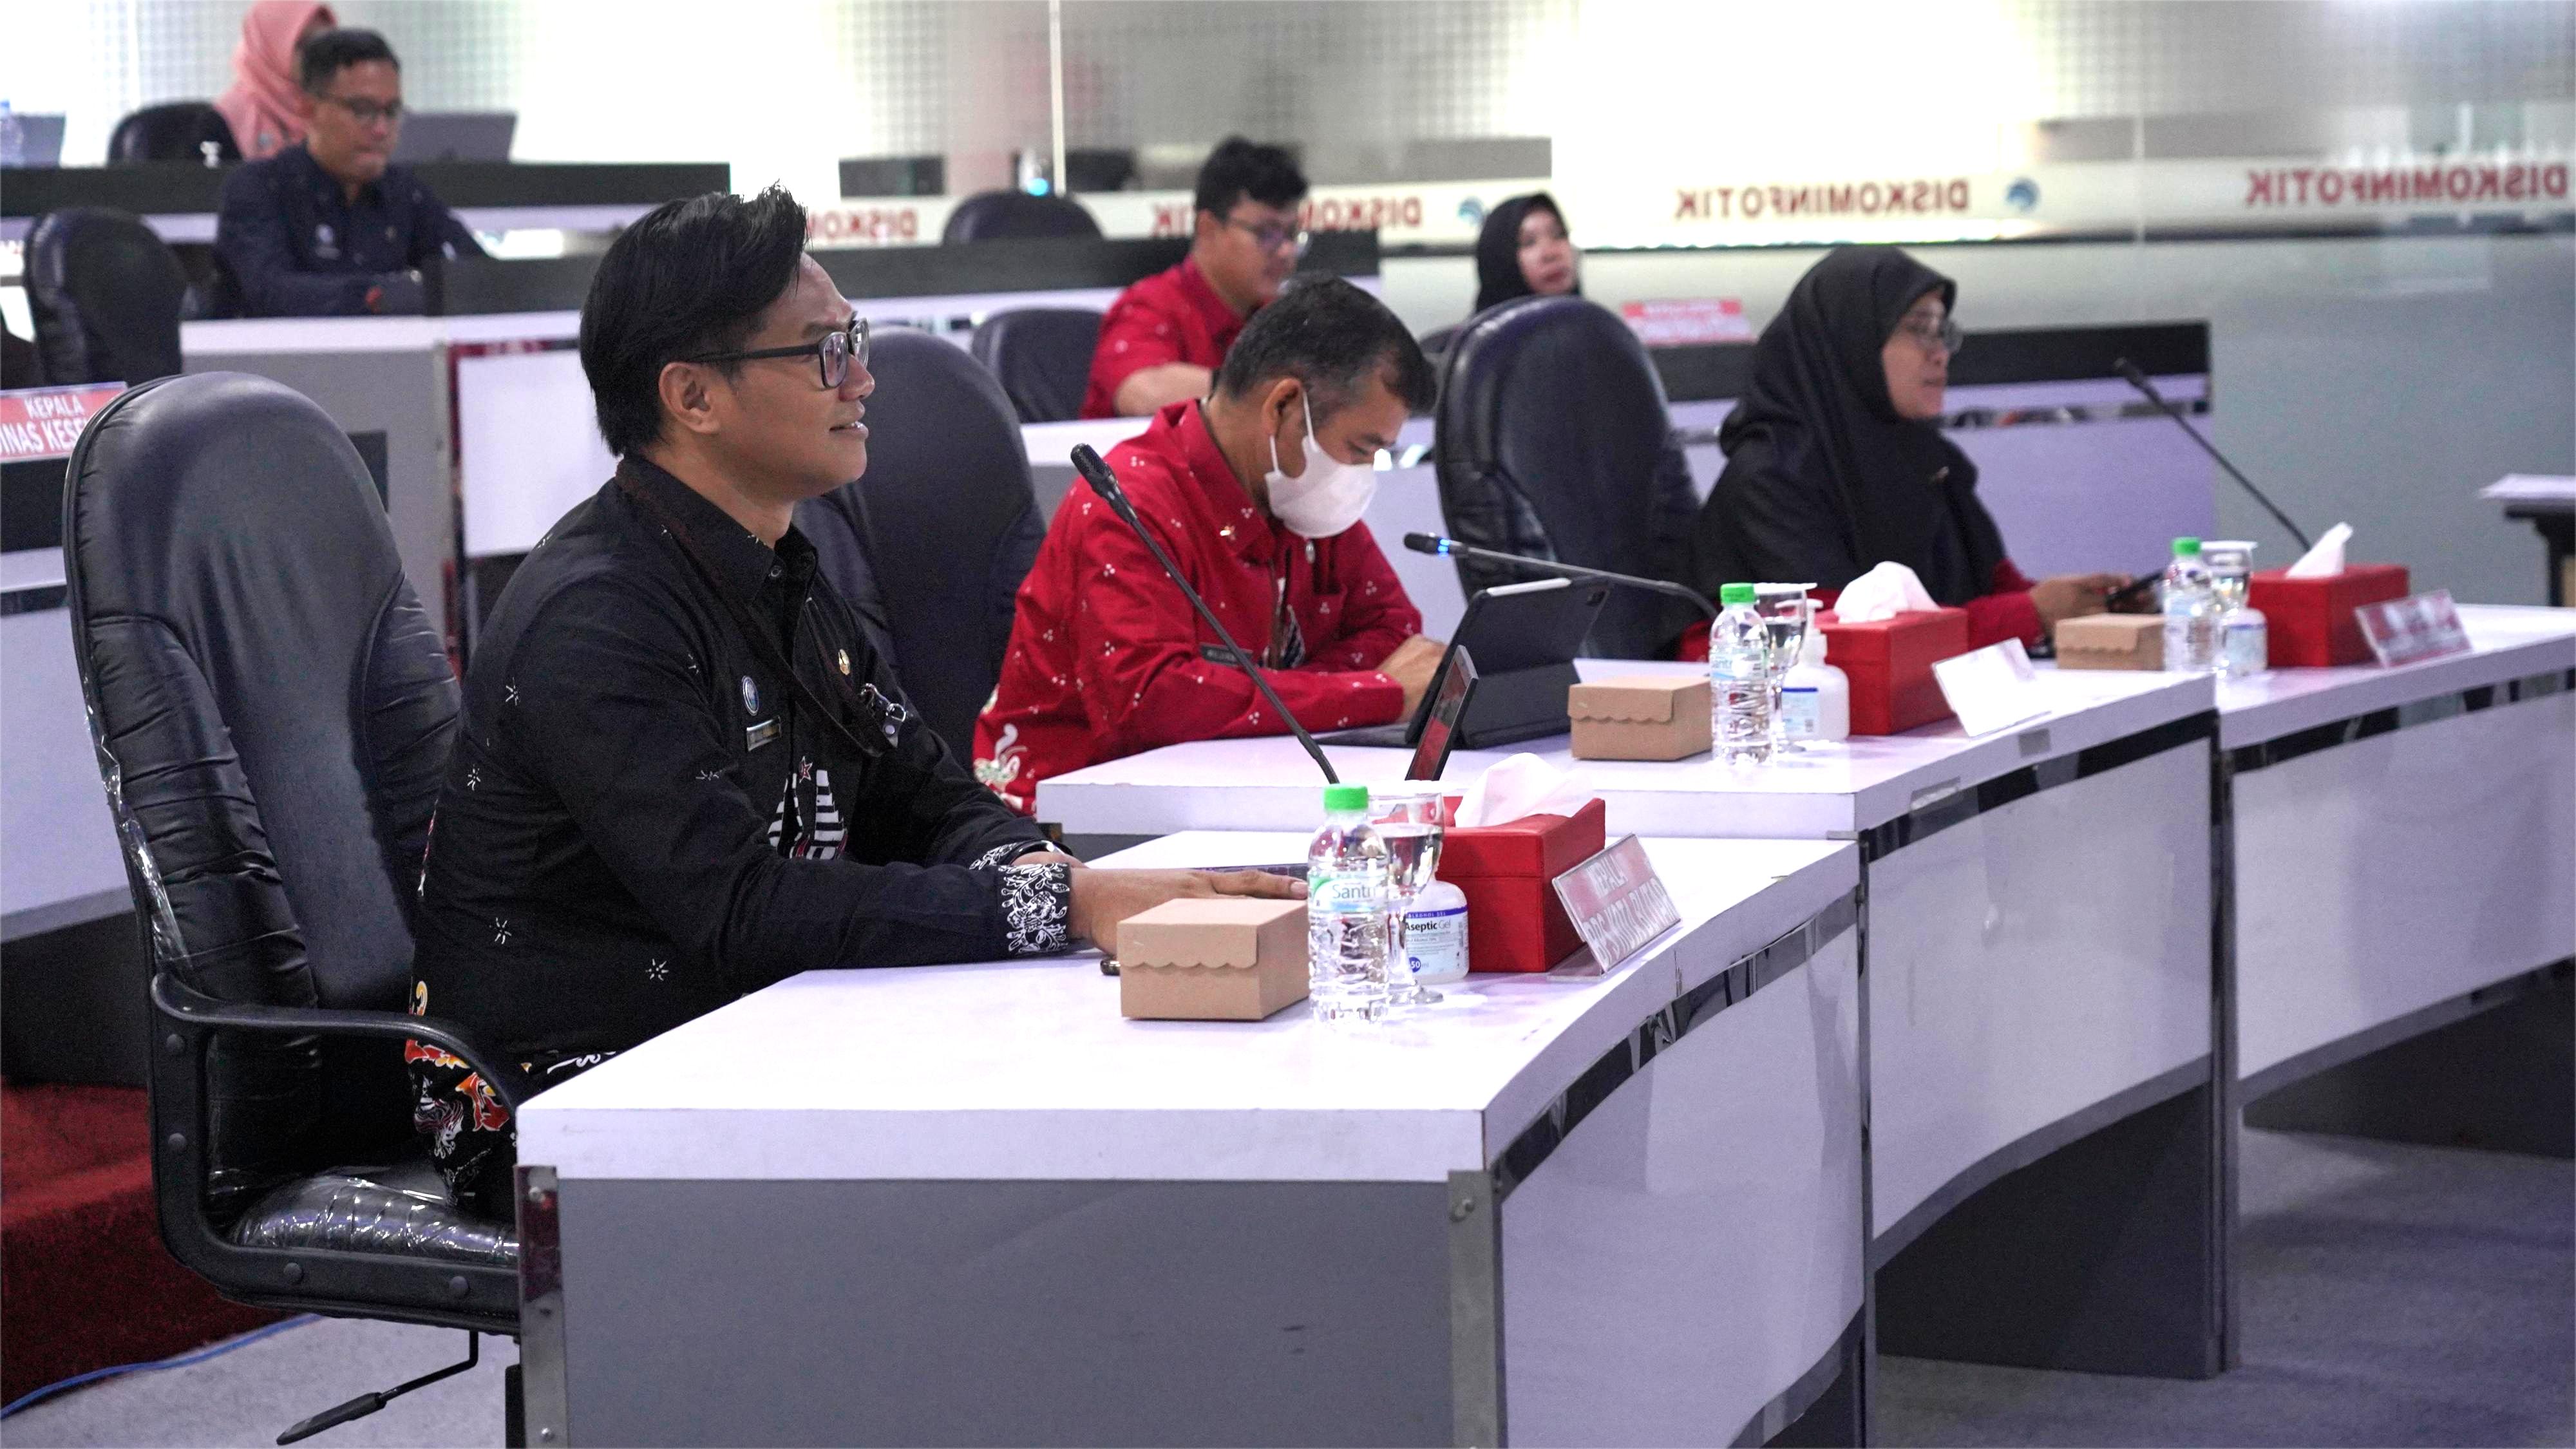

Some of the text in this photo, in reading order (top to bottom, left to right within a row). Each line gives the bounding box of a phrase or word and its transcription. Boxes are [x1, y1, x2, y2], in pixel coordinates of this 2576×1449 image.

[24, 395, 85, 419] KEPALA
[0, 420, 44, 454] INAS
[1405, 920, 1437, 933] Aseptic
[1604, 898, 1647, 954] KOTA
